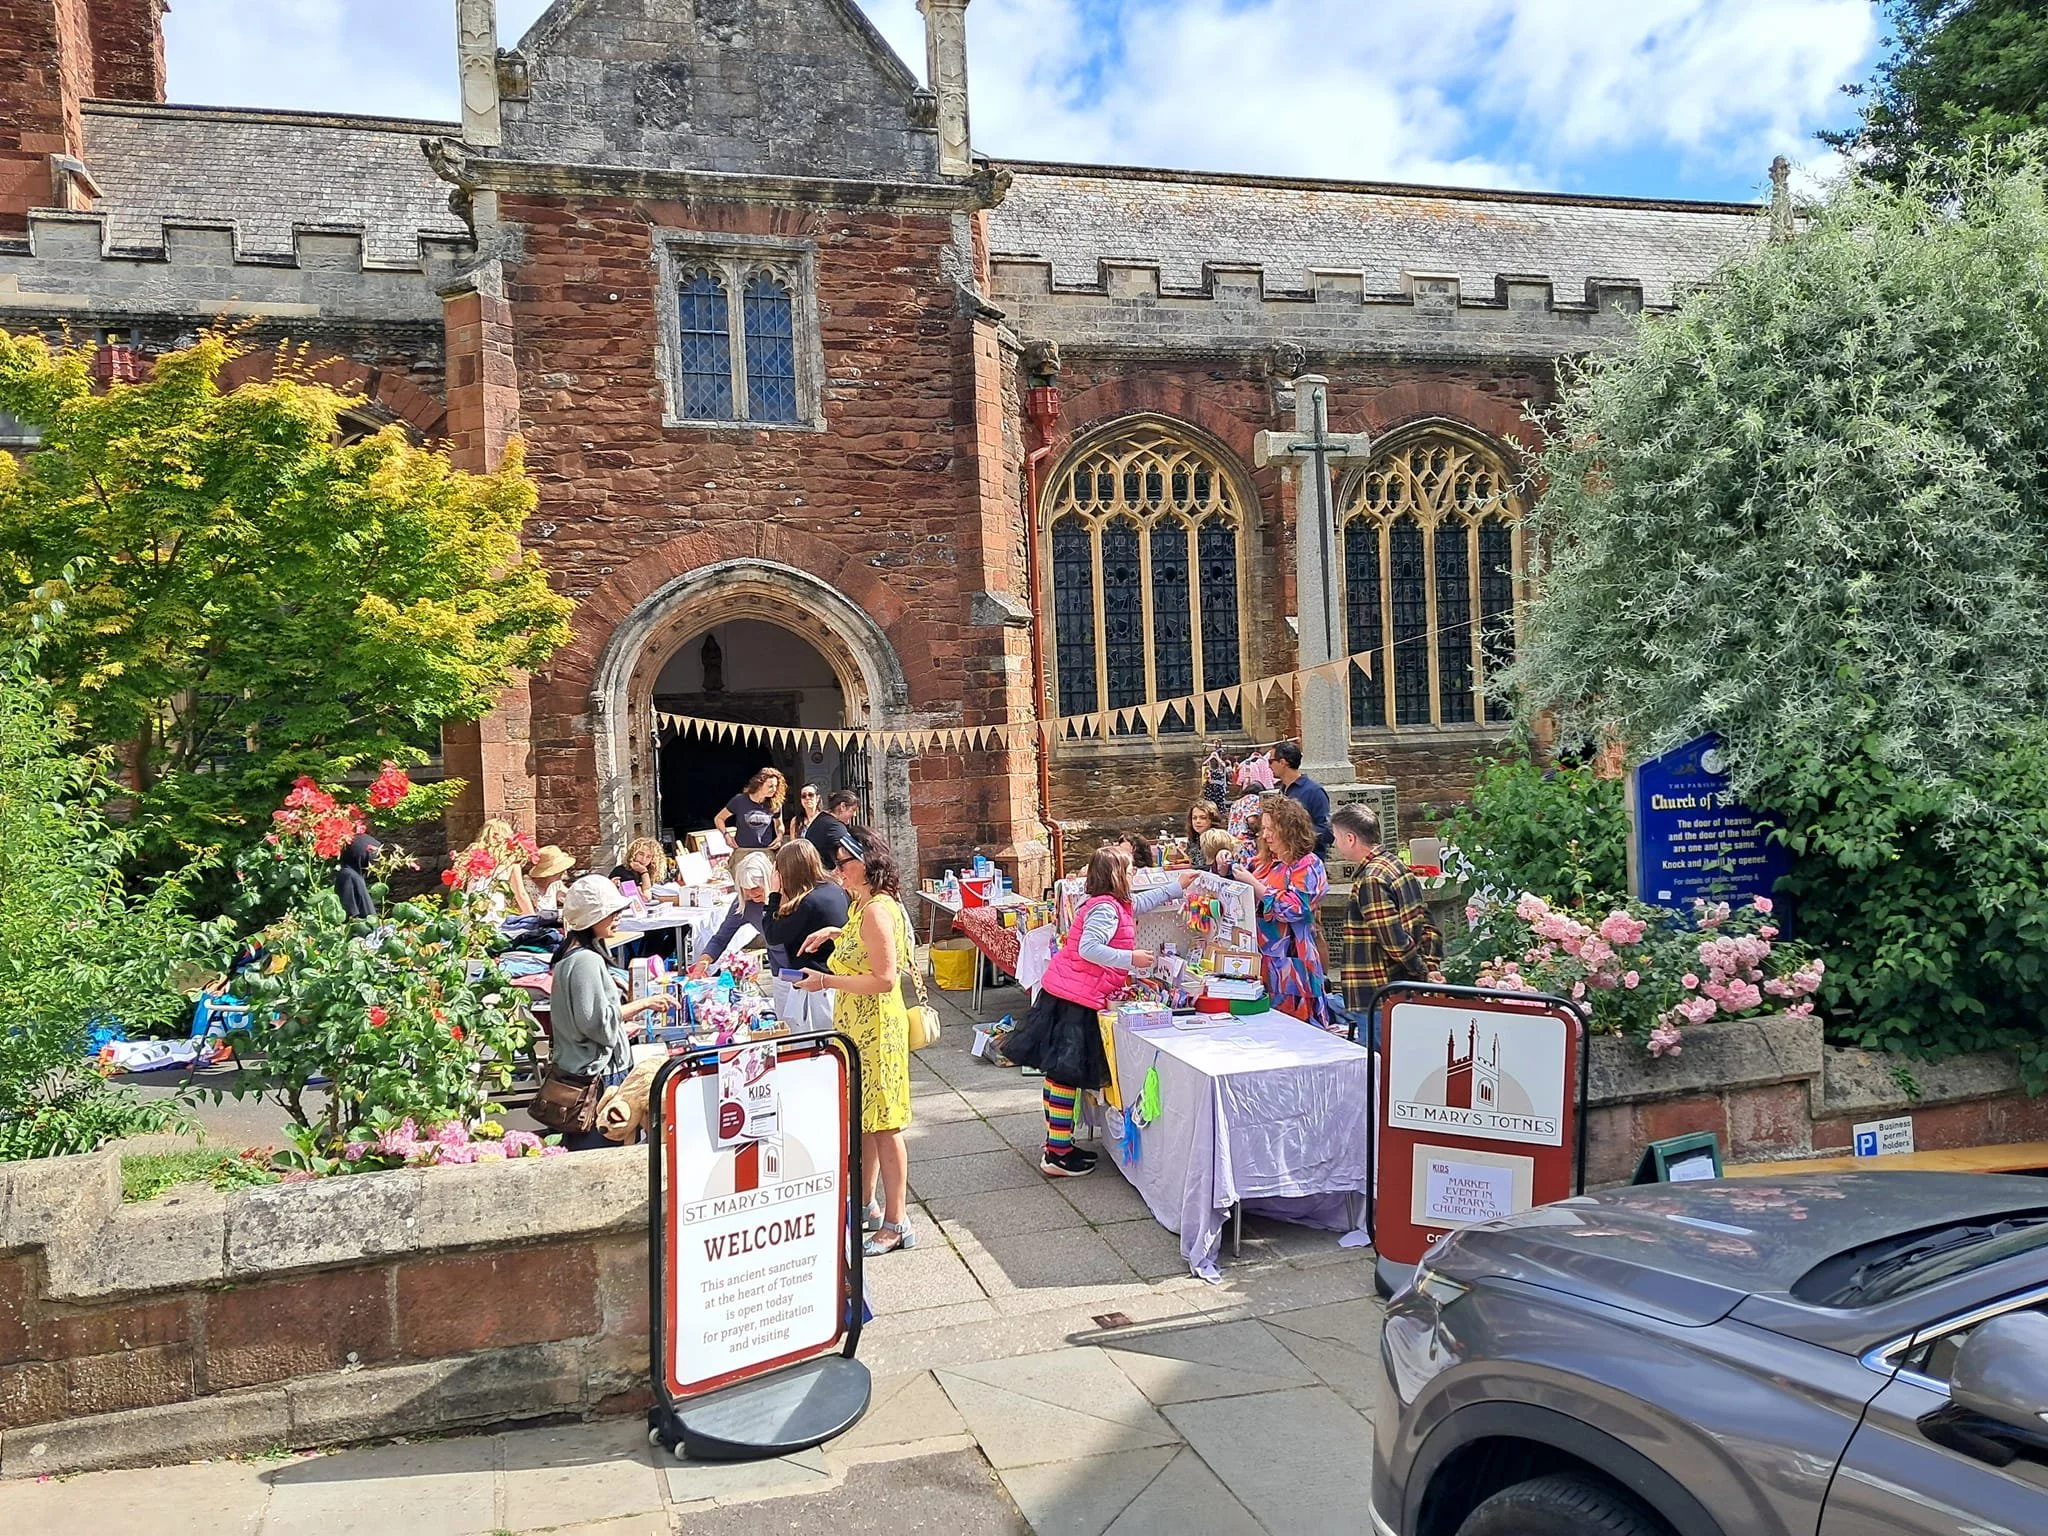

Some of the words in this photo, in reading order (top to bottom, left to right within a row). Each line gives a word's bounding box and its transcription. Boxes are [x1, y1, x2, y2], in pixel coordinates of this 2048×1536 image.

[1651, 793, 1696, 810] Church
[1700, 792, 1713, 811] of
[1677, 819, 1692, 829] The
[1693, 819, 1711, 828] door
[1713, 818, 1721, 827] of
[1724, 817, 1752, 826] heaven
[1668, 833, 1683, 841] and
[1684, 831, 1697, 840] the
[1699, 830, 1716, 839] door
[1718, 829, 1726, 838] of
[1727, 828, 1740, 838] the
[1741, 828, 1761, 837] heart
[1673, 845, 1686, 853] are
[1688, 844, 1702, 852] one
[1704, 842, 1719, 851] and
[1662, 860, 1686, 870] Knock
[1688, 858, 1702, 868] and
[748, 1083, 771, 1098] KIDS
[1424, 1108, 1482, 1126] MARY'S
[1488, 1115, 1554, 1133] TOTNES
[1879, 1121, 1911, 1132] Business
[1883, 1130, 1908, 1141] permit
[1860, 1134, 1874, 1155] P
[1882, 1140, 1910, 1150] holders
[1432, 1164, 1449, 1174] KIDS
[1448, 1177, 1490, 1190] MARKET
[713, 1191, 770, 1216] MARY'S
[774, 1176, 833, 1201] TOTNES
[1445, 1186, 1479, 1198] EVENT
[1482, 1190, 1493, 1200] IN
[1442, 1195, 1454, 1204] ST
[1458, 1197, 1496, 1209] MARY'S
[1432, 1203, 1476, 1216] CHURCH
[1480, 1209, 1504, 1219] NOW
[704, 1213, 815, 1262] WELCOME
[700, 1280, 724, 1293] This
[727, 1267, 766, 1286] ancient
[768, 1254, 818, 1275] sanctuary
[704, 1298, 716, 1310] at
[718, 1292, 735, 1306] the
[737, 1284, 765, 1301] heart
[767, 1278, 779, 1292] of
[780, 1272, 813, 1289] Totnes
[726, 1309, 735, 1321] is
[737, 1302, 763, 1319] open
[766, 1293, 794, 1309] today
[703, 1331, 719, 1345] for
[721, 1321, 757, 1342] prayer,
[759, 1304, 814, 1328] meditation
[729, 1337, 749, 1353] and
[752, 1327, 790, 1346] visiting
